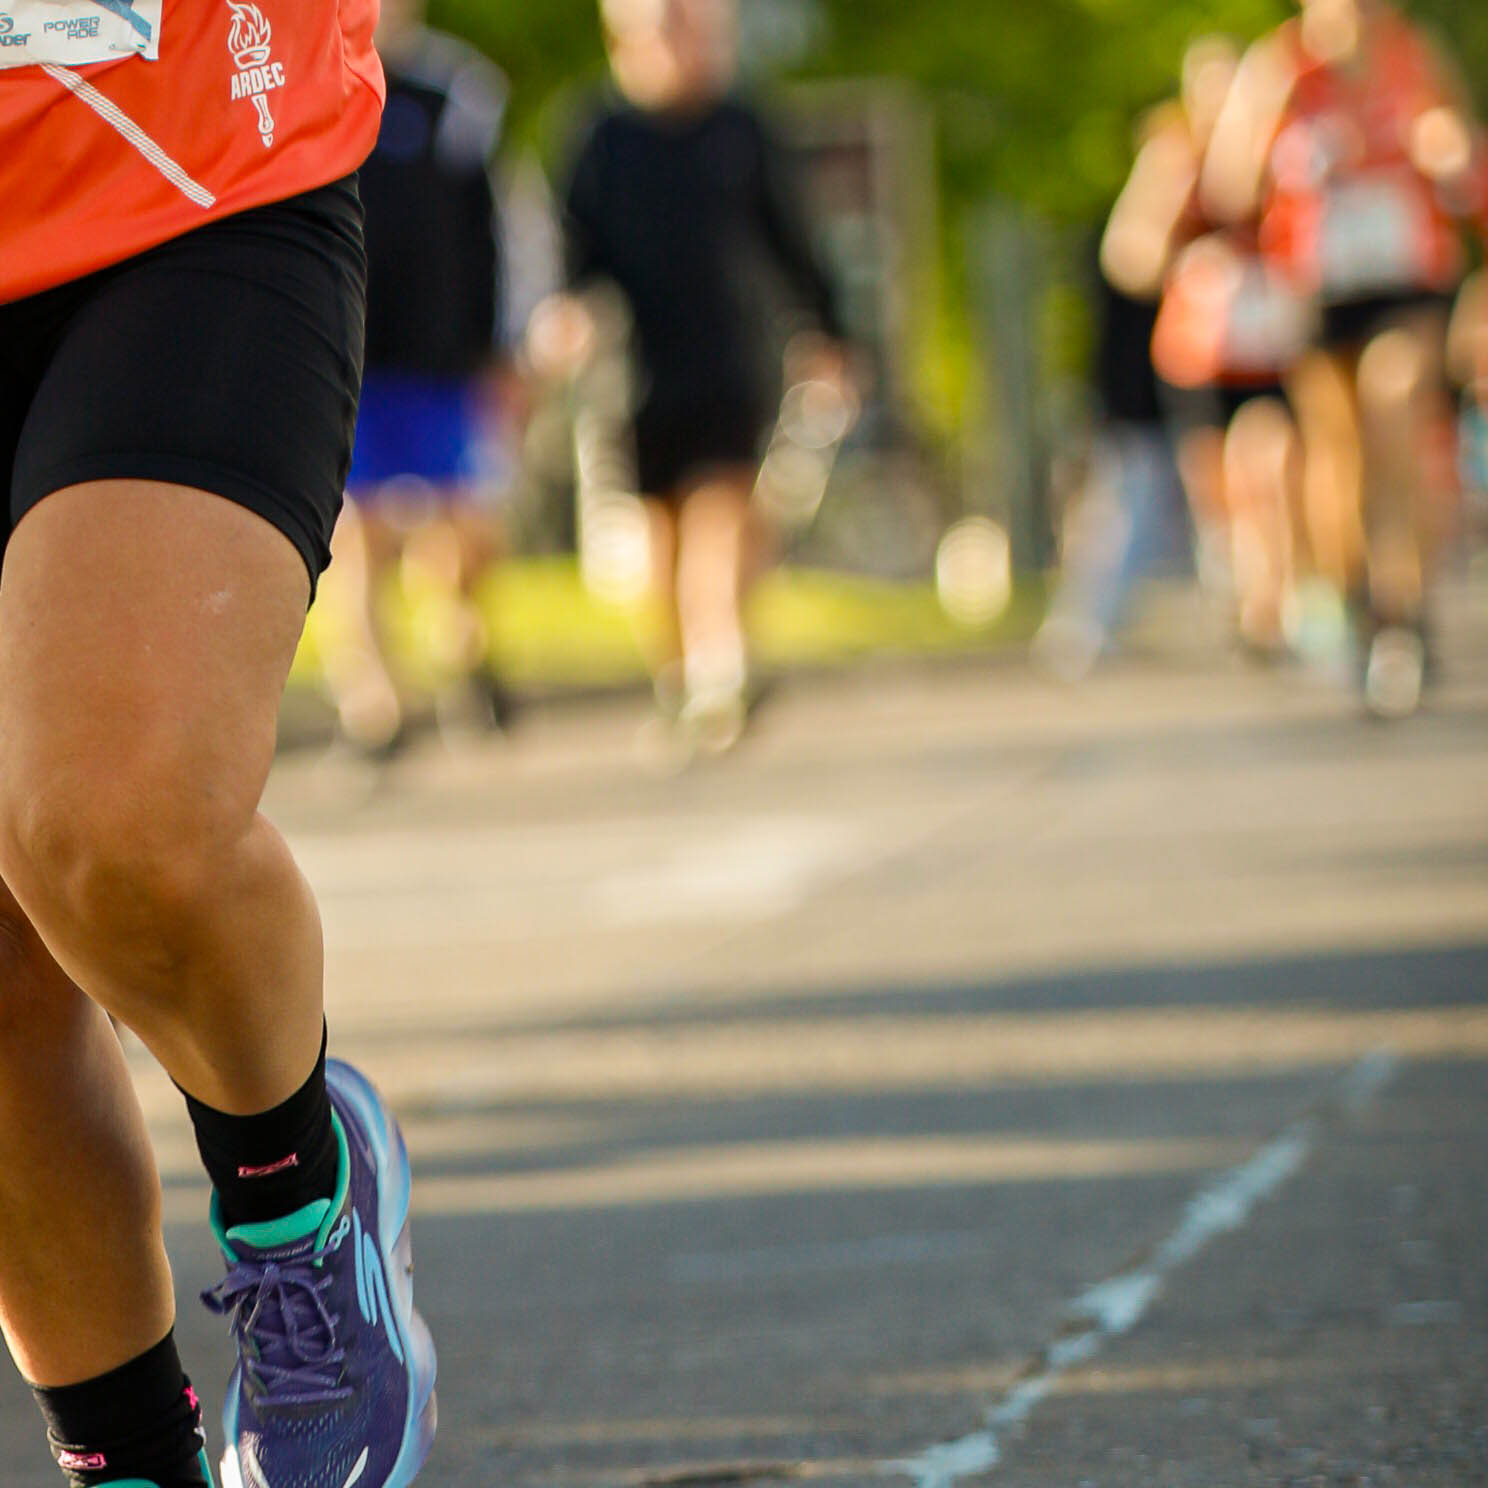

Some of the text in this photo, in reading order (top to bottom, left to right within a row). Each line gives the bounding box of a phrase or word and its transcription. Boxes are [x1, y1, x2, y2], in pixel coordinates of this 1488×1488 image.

[43, 15, 101, 32] POWER
[67, 26, 99, 40] ADE
[231, 62, 286, 101] ARDEC
